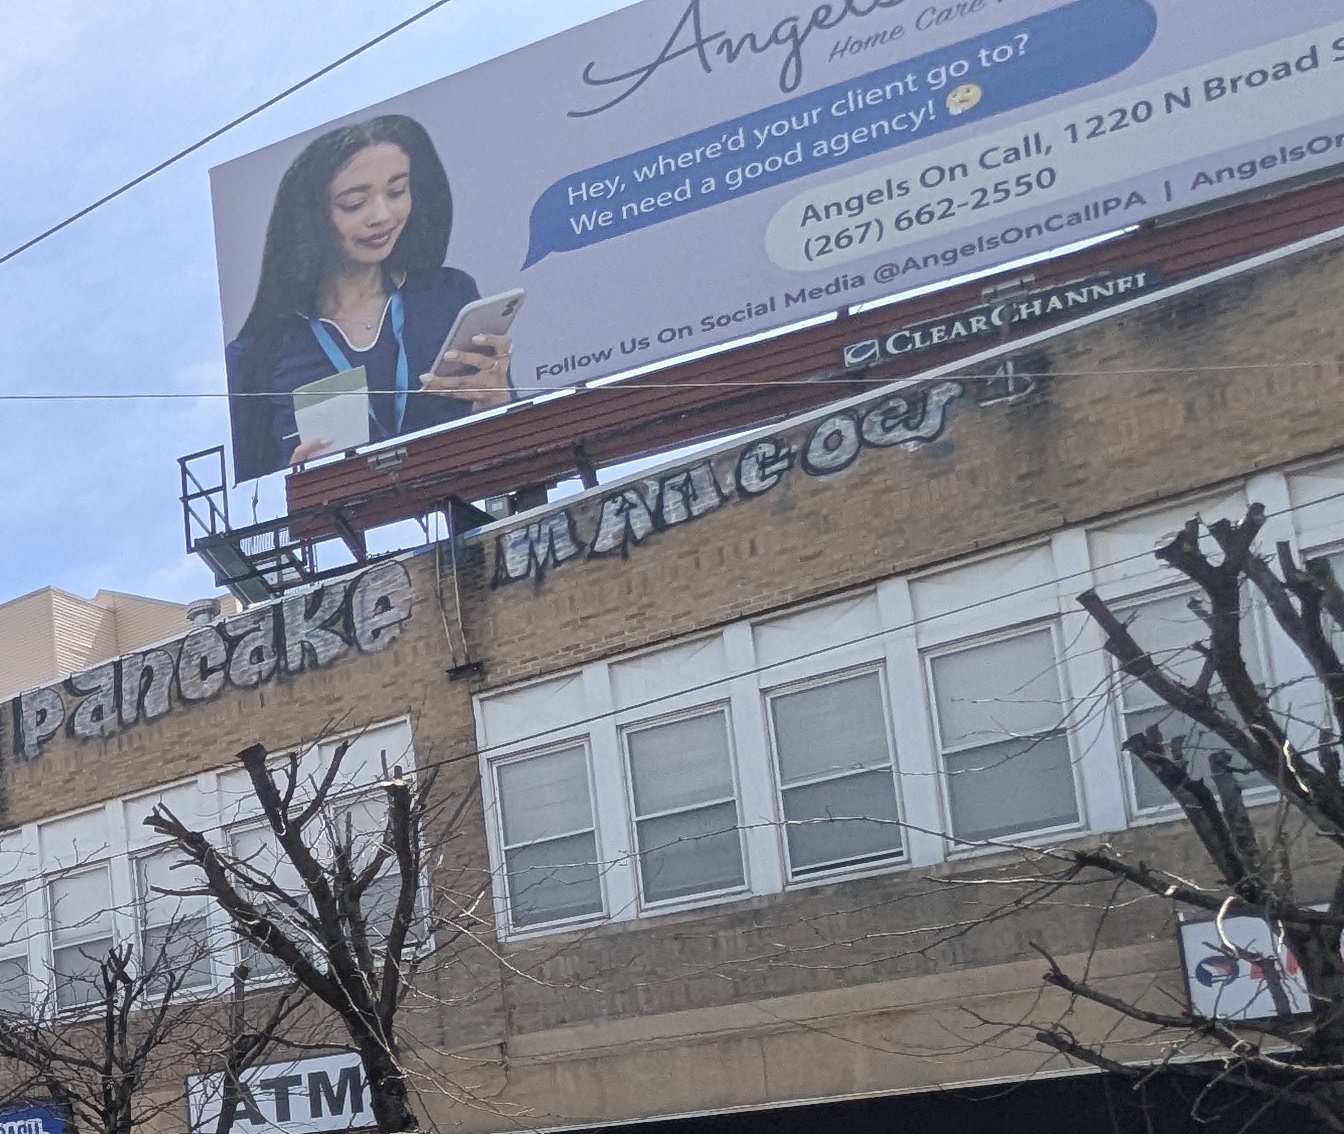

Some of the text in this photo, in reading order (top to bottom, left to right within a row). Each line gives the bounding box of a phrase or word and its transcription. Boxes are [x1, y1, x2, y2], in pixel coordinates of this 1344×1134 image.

[828, 25, 905, 63] Home
[567, 33, 1030, 206] Hey, where'd your client go to?
[569, 99, 938, 236] We need a good agency!
[800, 177, 912, 228] Angels
[918, 161, 969, 189] On
[978, 132, 1053, 170] Call,
[1063, 100, 1154, 144] 1220
[1164, 86, 1192, 114] N
[1202, 45, 1320, 102] Broad
[804, 165, 1057, 262] (267) 662-2550
[535, 346, 613, 381] Follow
[619, 331, 651, 356] Us
[657, 325, 694, 345] On
[700, 296, 777, 333] Social
[784, 271, 866, 308] Media
[873, 188, 1147, 285] @AngelsOnCallPA
[224, 1066, 364, 1128] ATM
